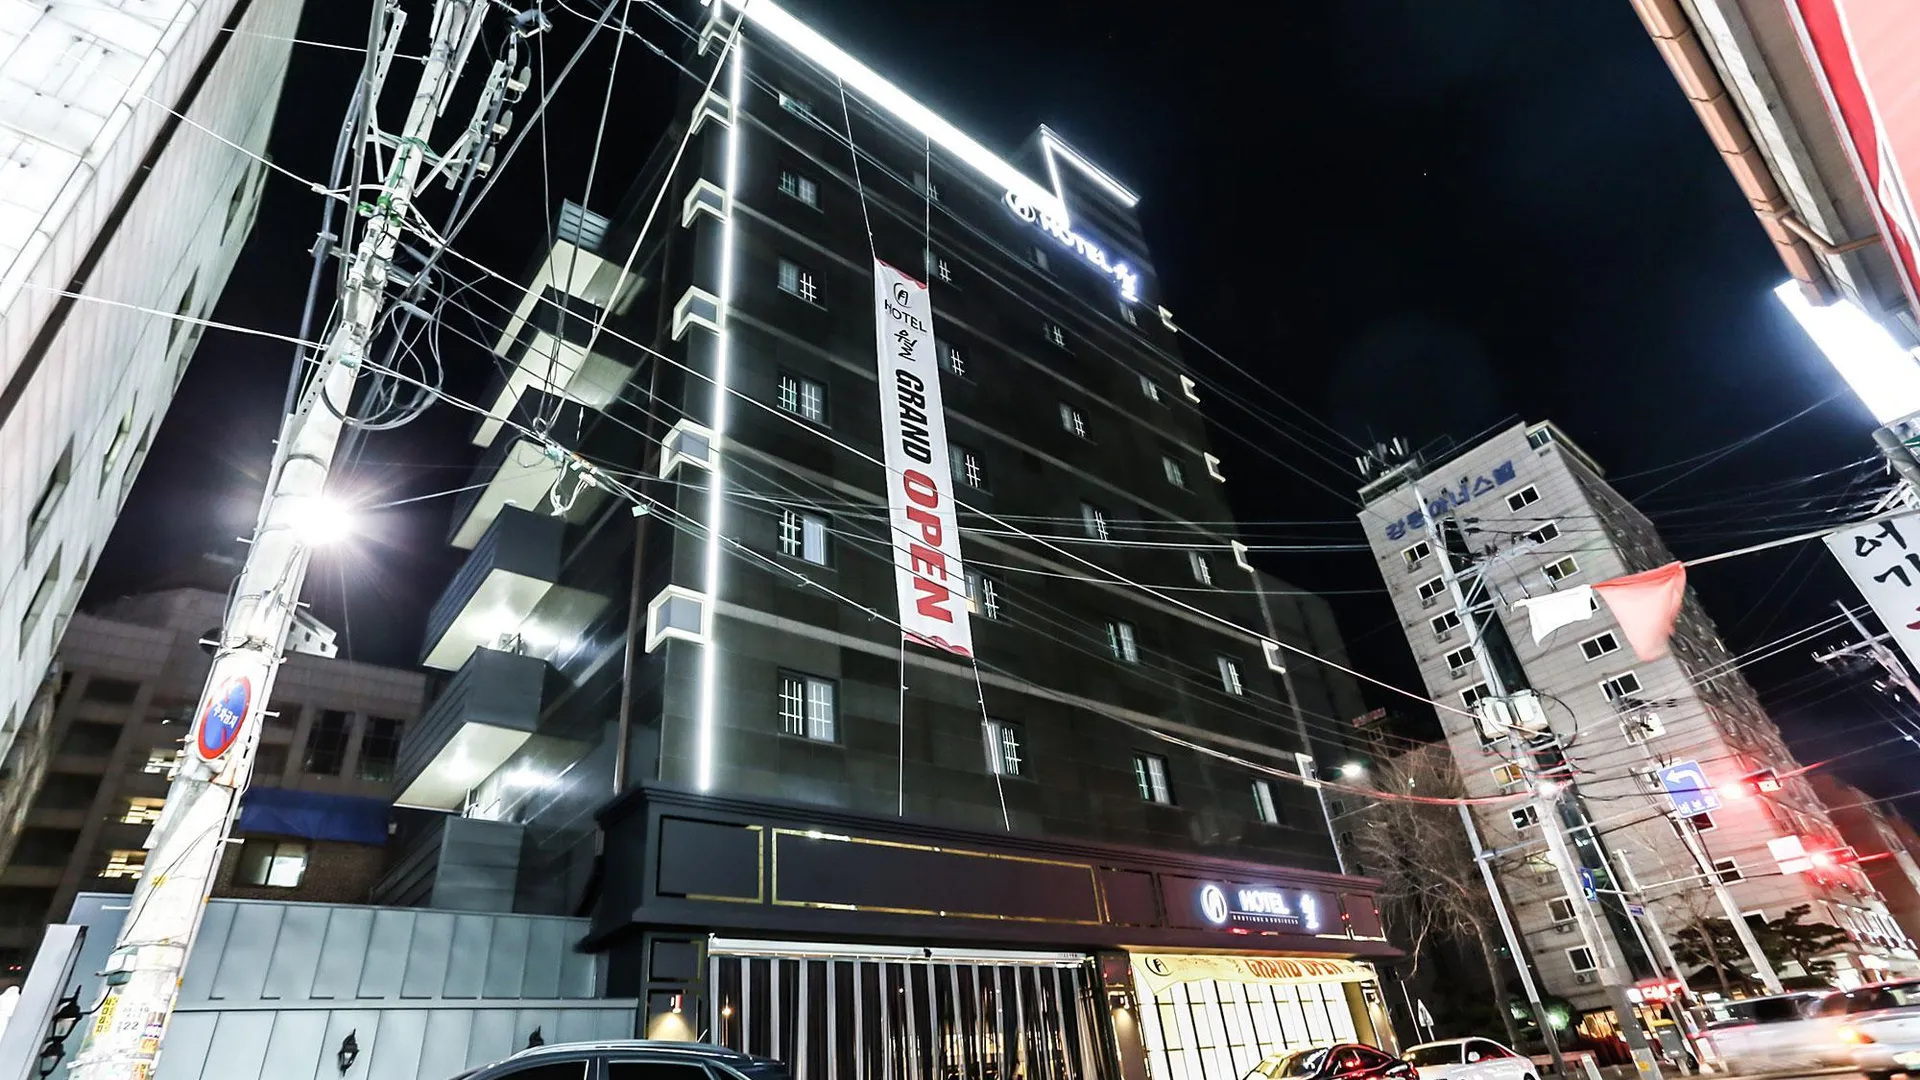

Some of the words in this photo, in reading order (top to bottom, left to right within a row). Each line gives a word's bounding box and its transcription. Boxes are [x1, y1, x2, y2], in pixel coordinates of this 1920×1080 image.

[884, 299, 927, 333] HOTEL
[895, 369, 932, 464] GRAND
[903, 468, 953, 624] OPEN
[213, 703, 239, 729] 주차금지
[1238, 889, 1290, 914] HOTEL
[1244, 959, 1302, 979] GRAND
[1301, 959, 1343, 976] OPEN
